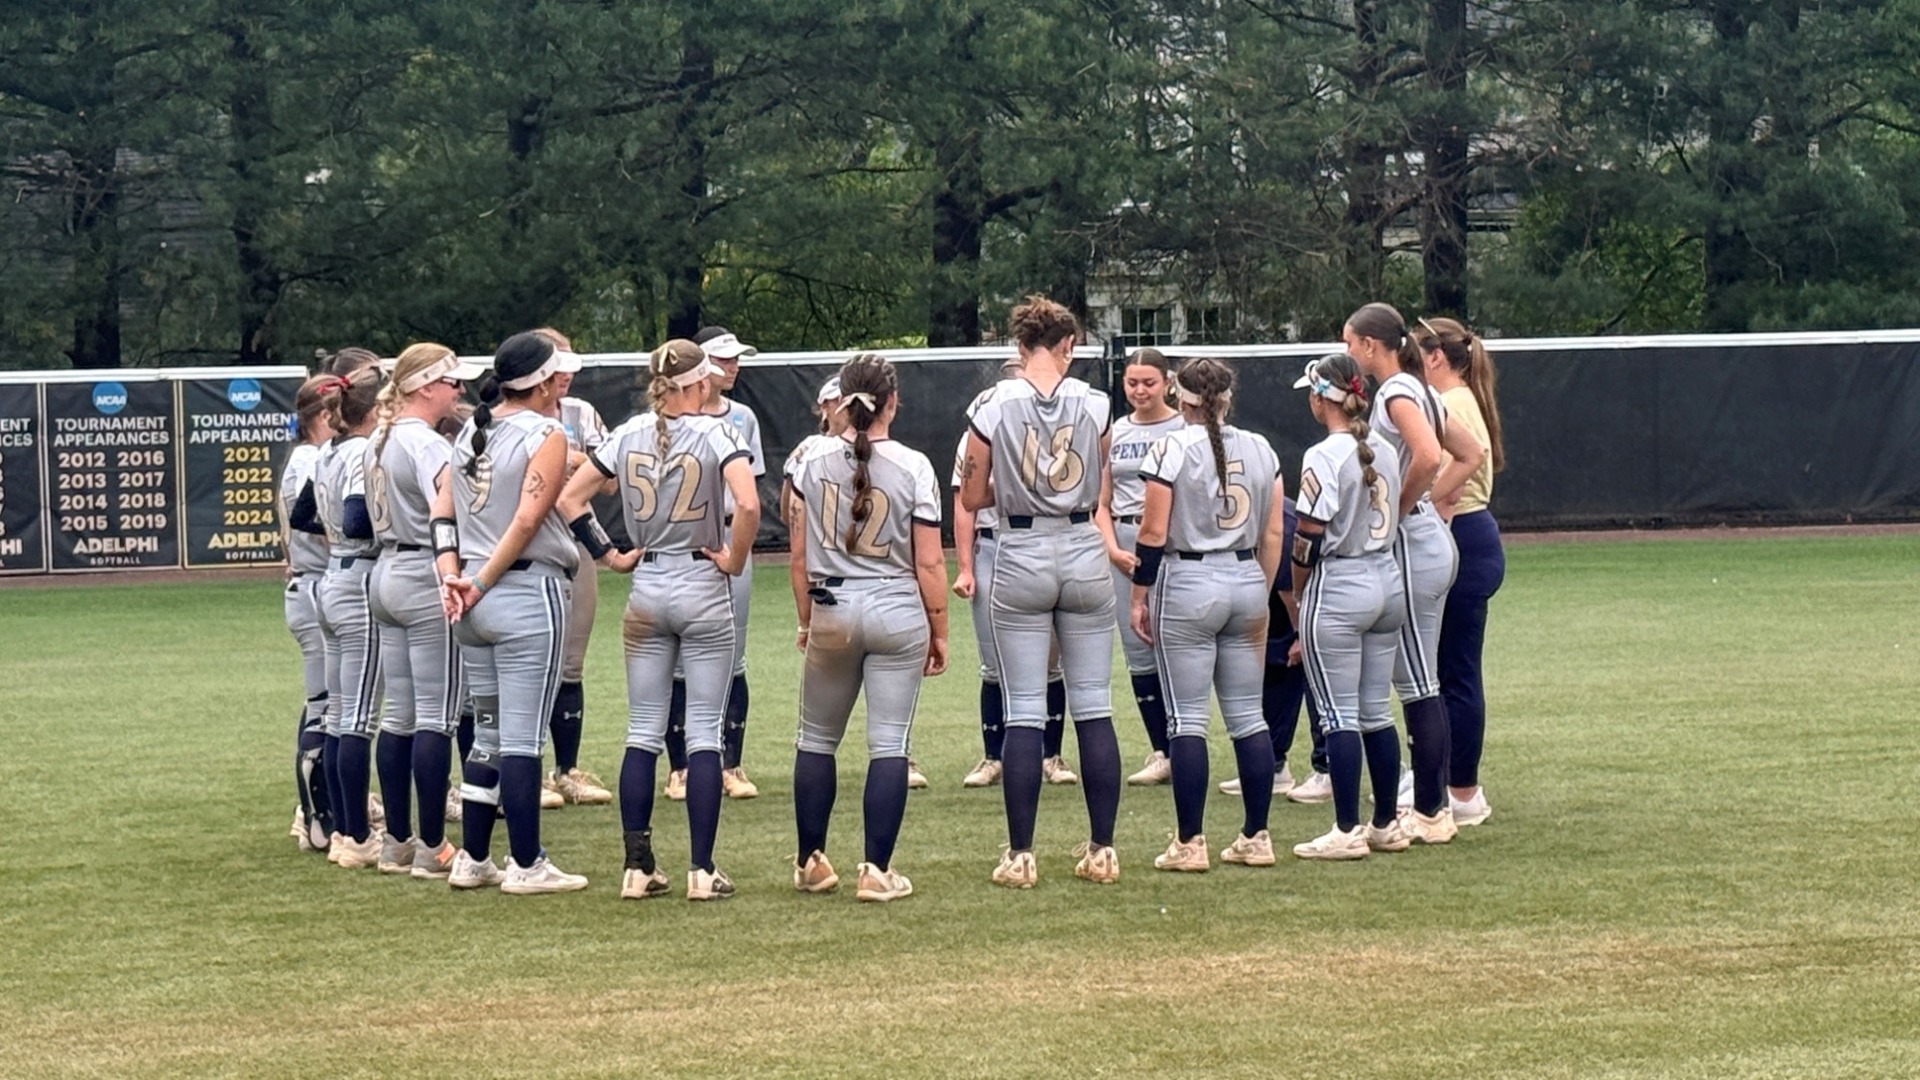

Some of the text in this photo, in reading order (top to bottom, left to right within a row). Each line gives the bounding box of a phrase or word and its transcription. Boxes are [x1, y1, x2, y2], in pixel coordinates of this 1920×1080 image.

[96, 395, 126, 406] NCAA
[231, 391, 261, 402] NCAA
[55, 416, 167, 432] TOURNAMENT
[0, 433, 33, 447] CES
[53, 431, 170, 447] APPEARANCES
[58, 450, 165, 468] 2012 2016
[223, 446, 270, 463] 2021
[58, 471, 165, 489] 2013 2017
[223, 467, 273, 484] 2022
[626, 451, 708, 523] 52
[1215, 459, 1251, 530] 5
[60, 492, 166, 510] 2014 2018
[223, 488, 273, 505] 2023
[1368, 472, 1392, 540] 3
[61, 513, 167, 531] 2015 2019
[223, 509, 274, 526] 2024
[819, 478, 892, 558] 12
[72, 536, 159, 554] ADELPHI
[207, 531, 281, 549] ADELPH
[90, 556, 141, 565] SOFTBALL
[225, 550, 276, 560] SOFTBALL
